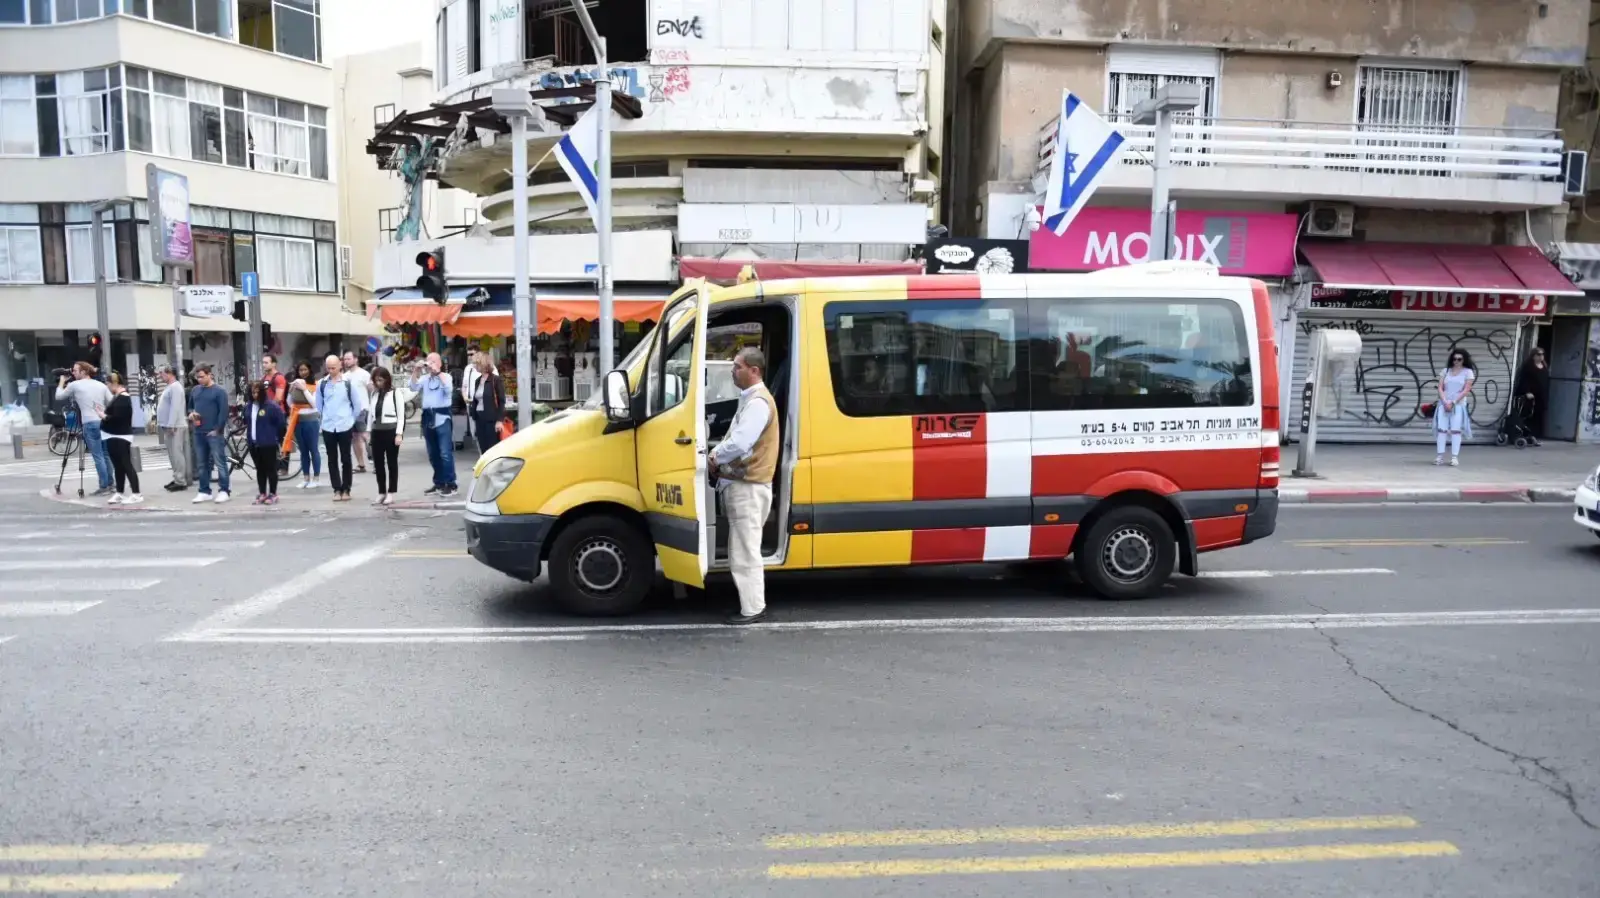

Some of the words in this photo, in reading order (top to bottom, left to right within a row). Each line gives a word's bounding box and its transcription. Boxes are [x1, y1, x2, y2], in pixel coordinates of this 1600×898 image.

[1133, 421, 1155, 433] קווים
[1160, 420, 1184, 431] אביב
[1186, 419, 1200, 430] תל
[1206, 418, 1232, 430] מוניות
[1237, 416, 1259, 429] ארגון
